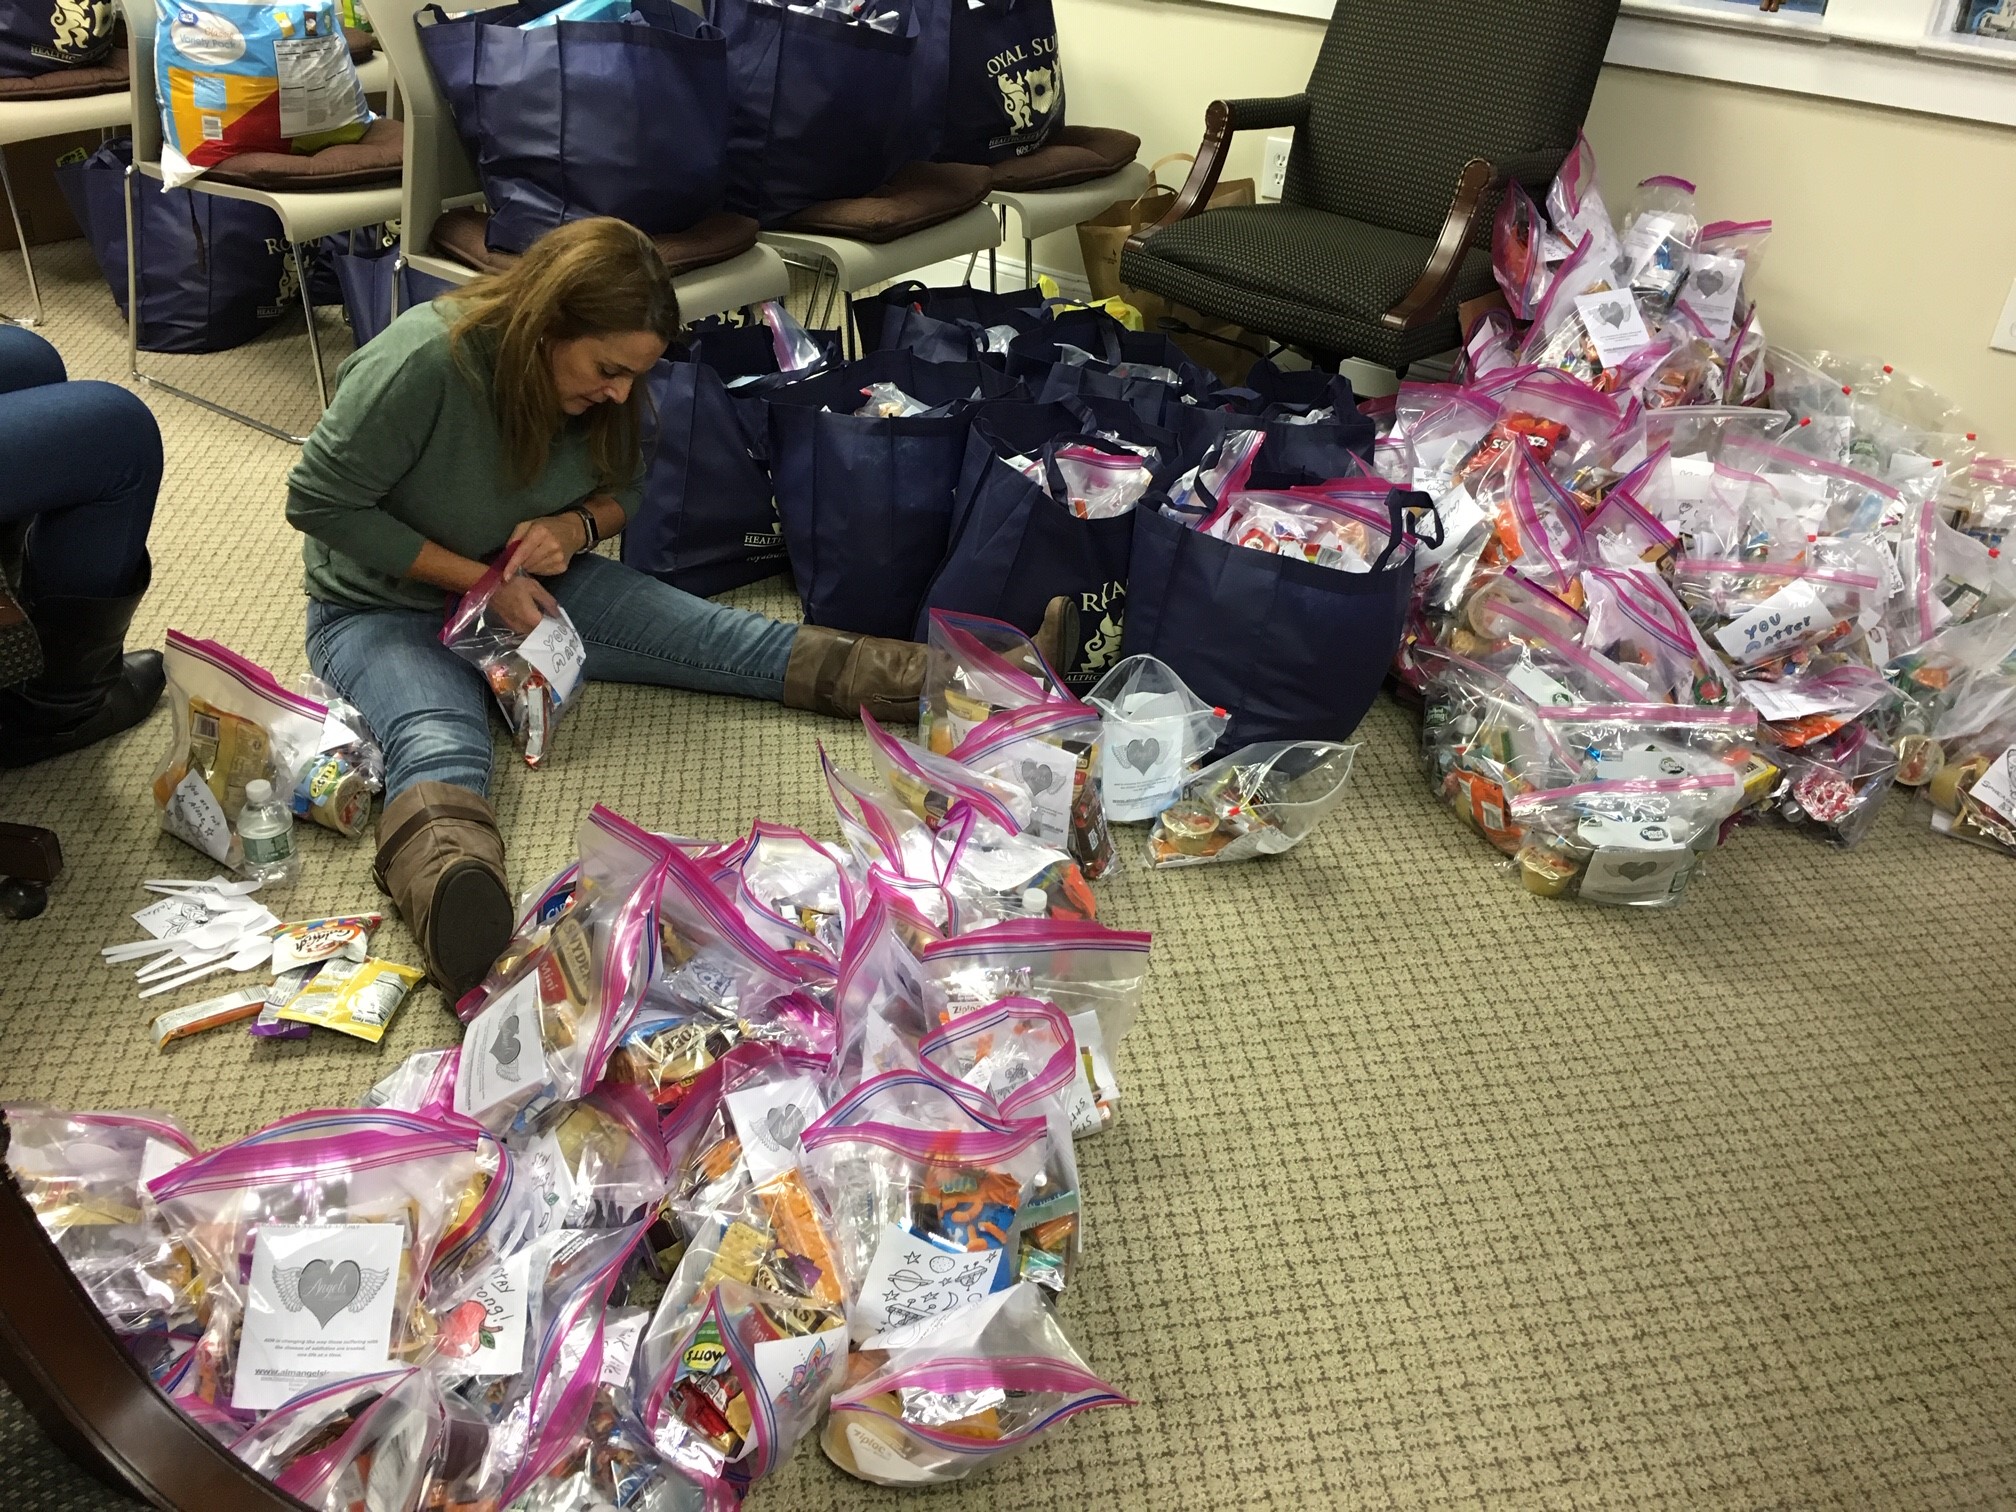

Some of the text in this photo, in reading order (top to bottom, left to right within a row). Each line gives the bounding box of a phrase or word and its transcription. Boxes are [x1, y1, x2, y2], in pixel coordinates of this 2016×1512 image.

[180, 34, 236, 48] Variety Pack
[987, 35, 1055, 77] OYAL SU
[1744, 613, 1781, 640] YOU
[541, 961, 559, 991] Mini
[302, 1274, 347, 1297] Angels
